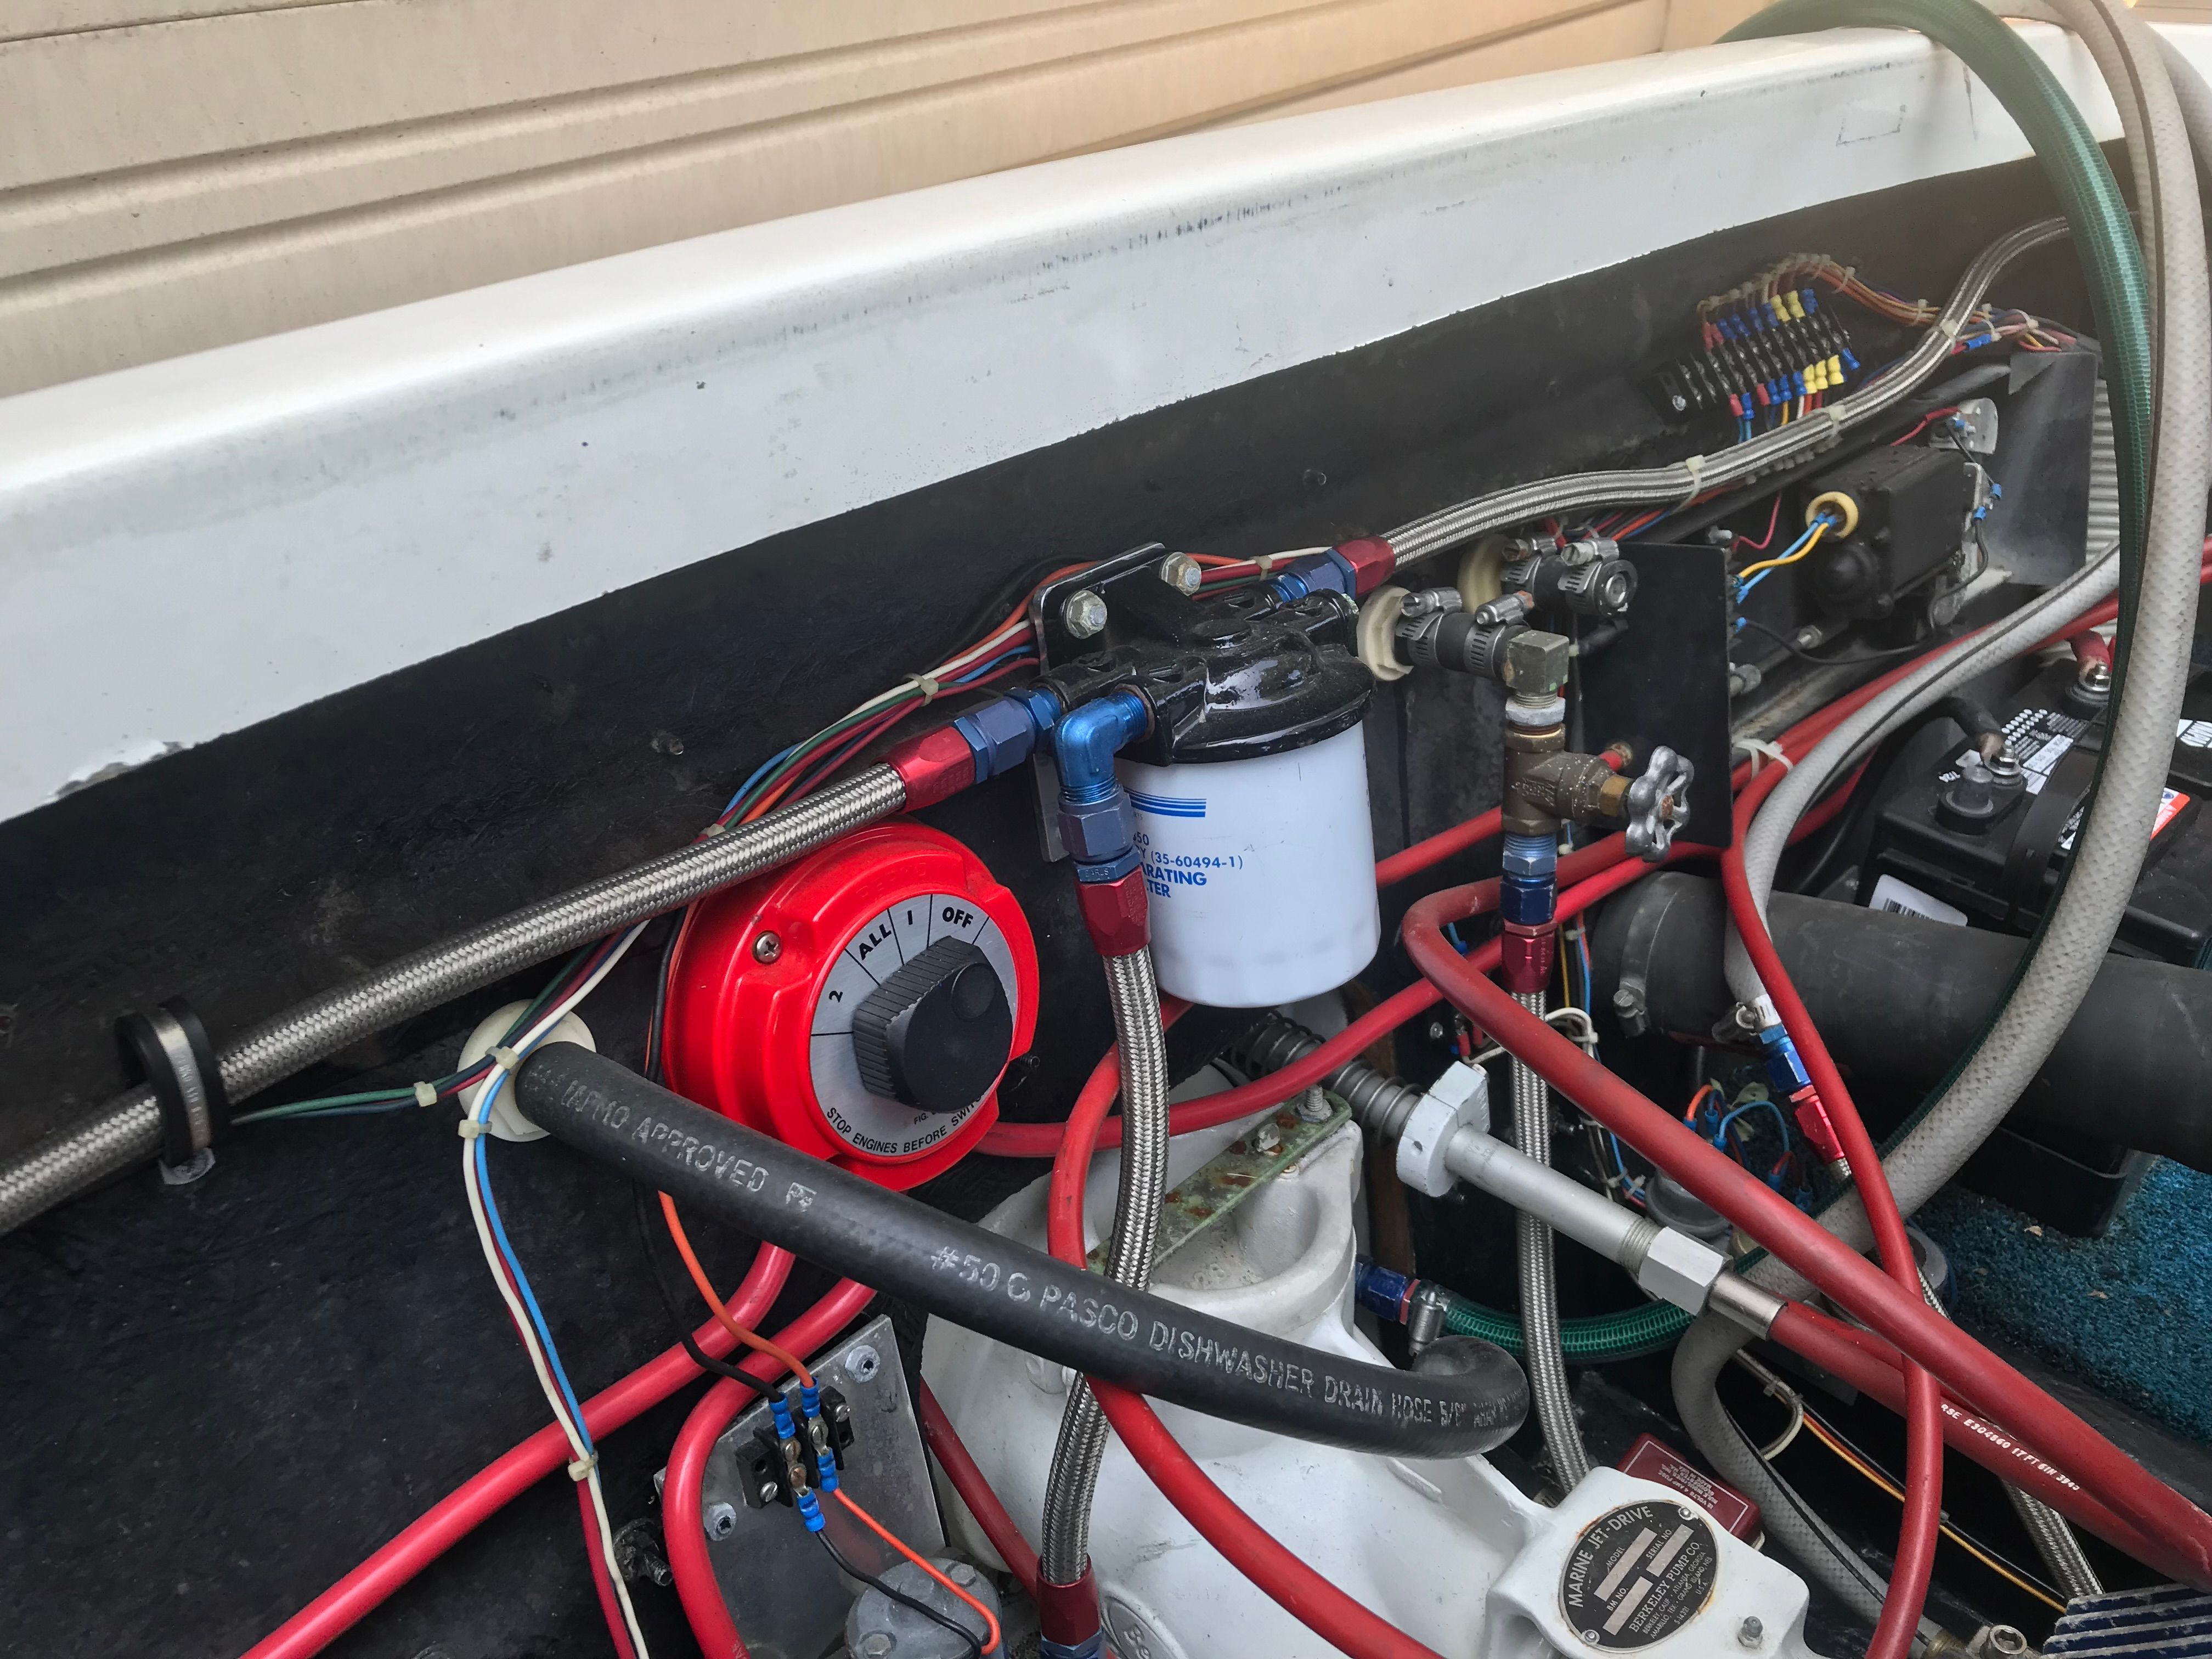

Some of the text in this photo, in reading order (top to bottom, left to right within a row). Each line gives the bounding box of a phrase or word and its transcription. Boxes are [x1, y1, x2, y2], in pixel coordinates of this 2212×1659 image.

[1152, 850, 1243, 870] (35-60494-1)
[1147, 880, 1171, 898] TER
[828, 990, 843, 1003] 2
[859, 923, 891, 960] ALL
[942, 906, 974, 928] OFF
[826, 1107, 851, 1135] STOP
[852, 1132, 898, 1153] ENGINES
[903, 1125, 947, 1153] BEFORE
[631, 1117, 769, 1193] APPROVED
[1040, 1284, 1139, 1341] PASCO
[1149, 1321, 1315, 1398] DISHWASHER
[1324, 1375, 1383, 1417] DRAIN
[1391, 1392, 1432, 1424] HOSE
[2023, 1454, 2040, 1465] FT
[1606, 1546, 1626, 1568] MODEL
[1645, 1539, 1664, 1559] SERIAL
[1688, 1551, 1707, 1572] GEORGIA
[1568, 1549, 1594, 1607] MARINE
[1606, 1587, 1629, 1611] BM NO.
[1628, 1580, 1670, 1633] BERKELEY
[1666, 1554, 1690, 1582] PUMP
[1677, 1583, 1692, 1601] GRAND
